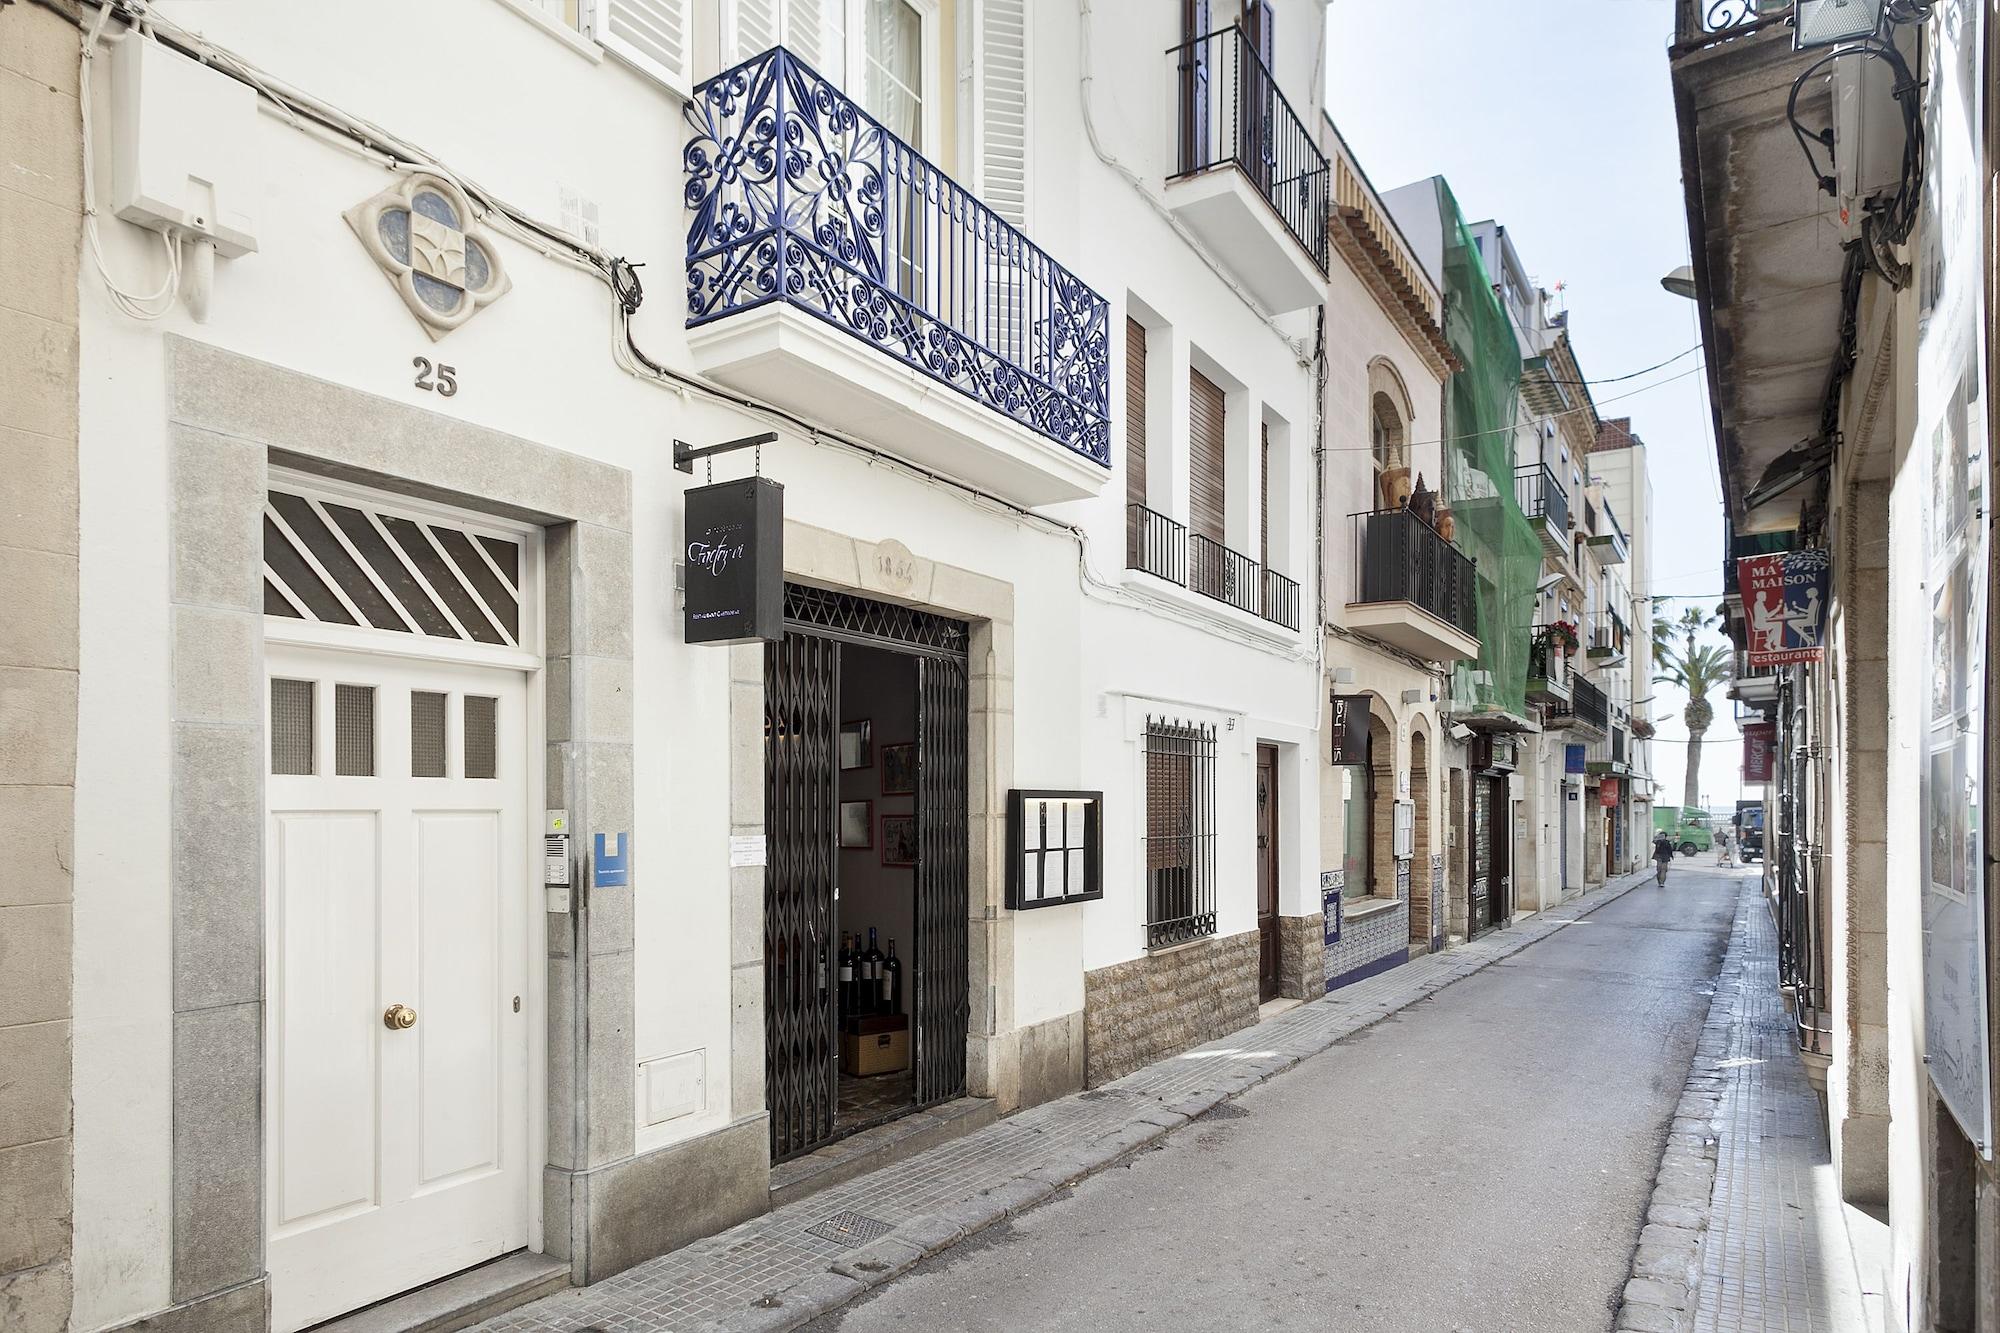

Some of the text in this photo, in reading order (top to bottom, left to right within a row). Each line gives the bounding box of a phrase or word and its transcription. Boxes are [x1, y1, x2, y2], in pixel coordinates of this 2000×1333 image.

[413, 356, 458, 397] 25
[1751, 565, 1777, 577] MA
[1751, 574, 1817, 589] MAISON
[1750, 738, 1765, 774] MERCAT
